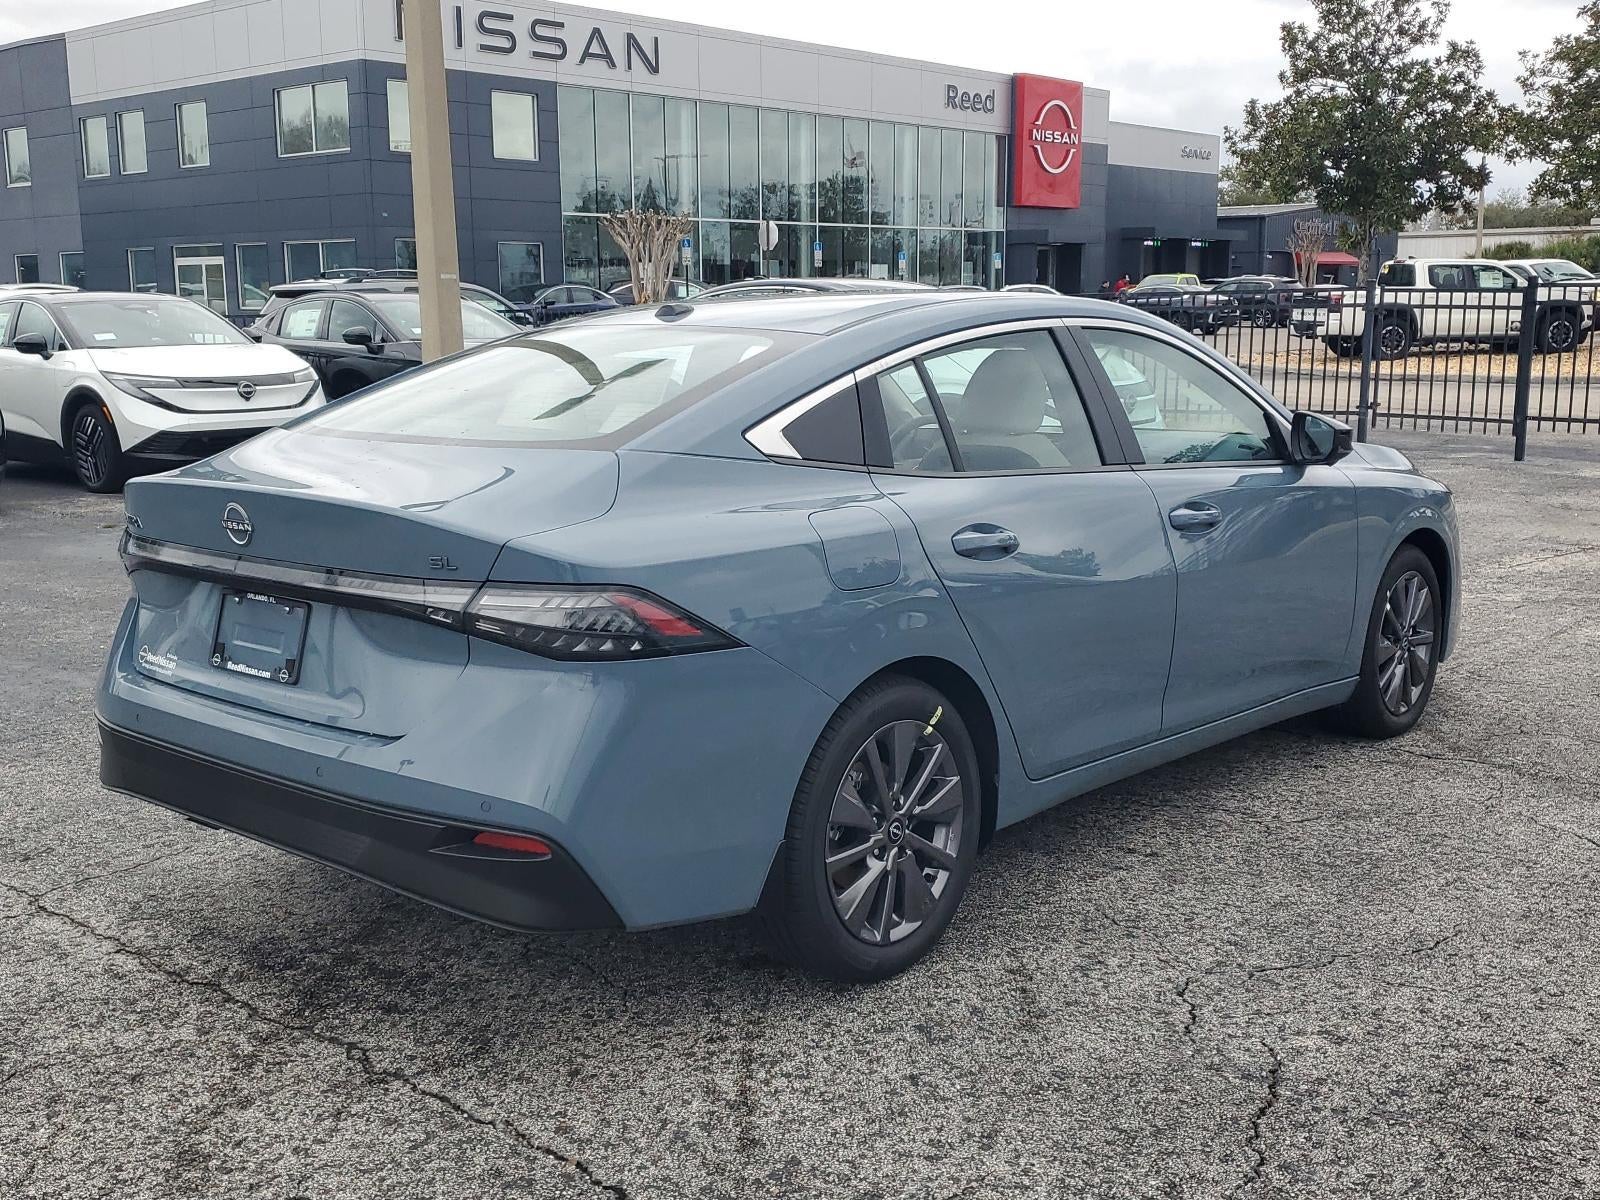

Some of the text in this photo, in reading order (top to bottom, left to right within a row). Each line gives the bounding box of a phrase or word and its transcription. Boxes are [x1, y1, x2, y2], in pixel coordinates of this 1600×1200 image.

[394, 0, 660, 75] ISSAN
[944, 83, 996, 114] Reed
[1032, 128, 1079, 145] NISSAN
[1181, 145, 1212, 161] Service
[222, 520, 252, 533] NISSAN
[428, 555, 458, 571] SL
[226, 661, 271, 678] ReedNissan.com
